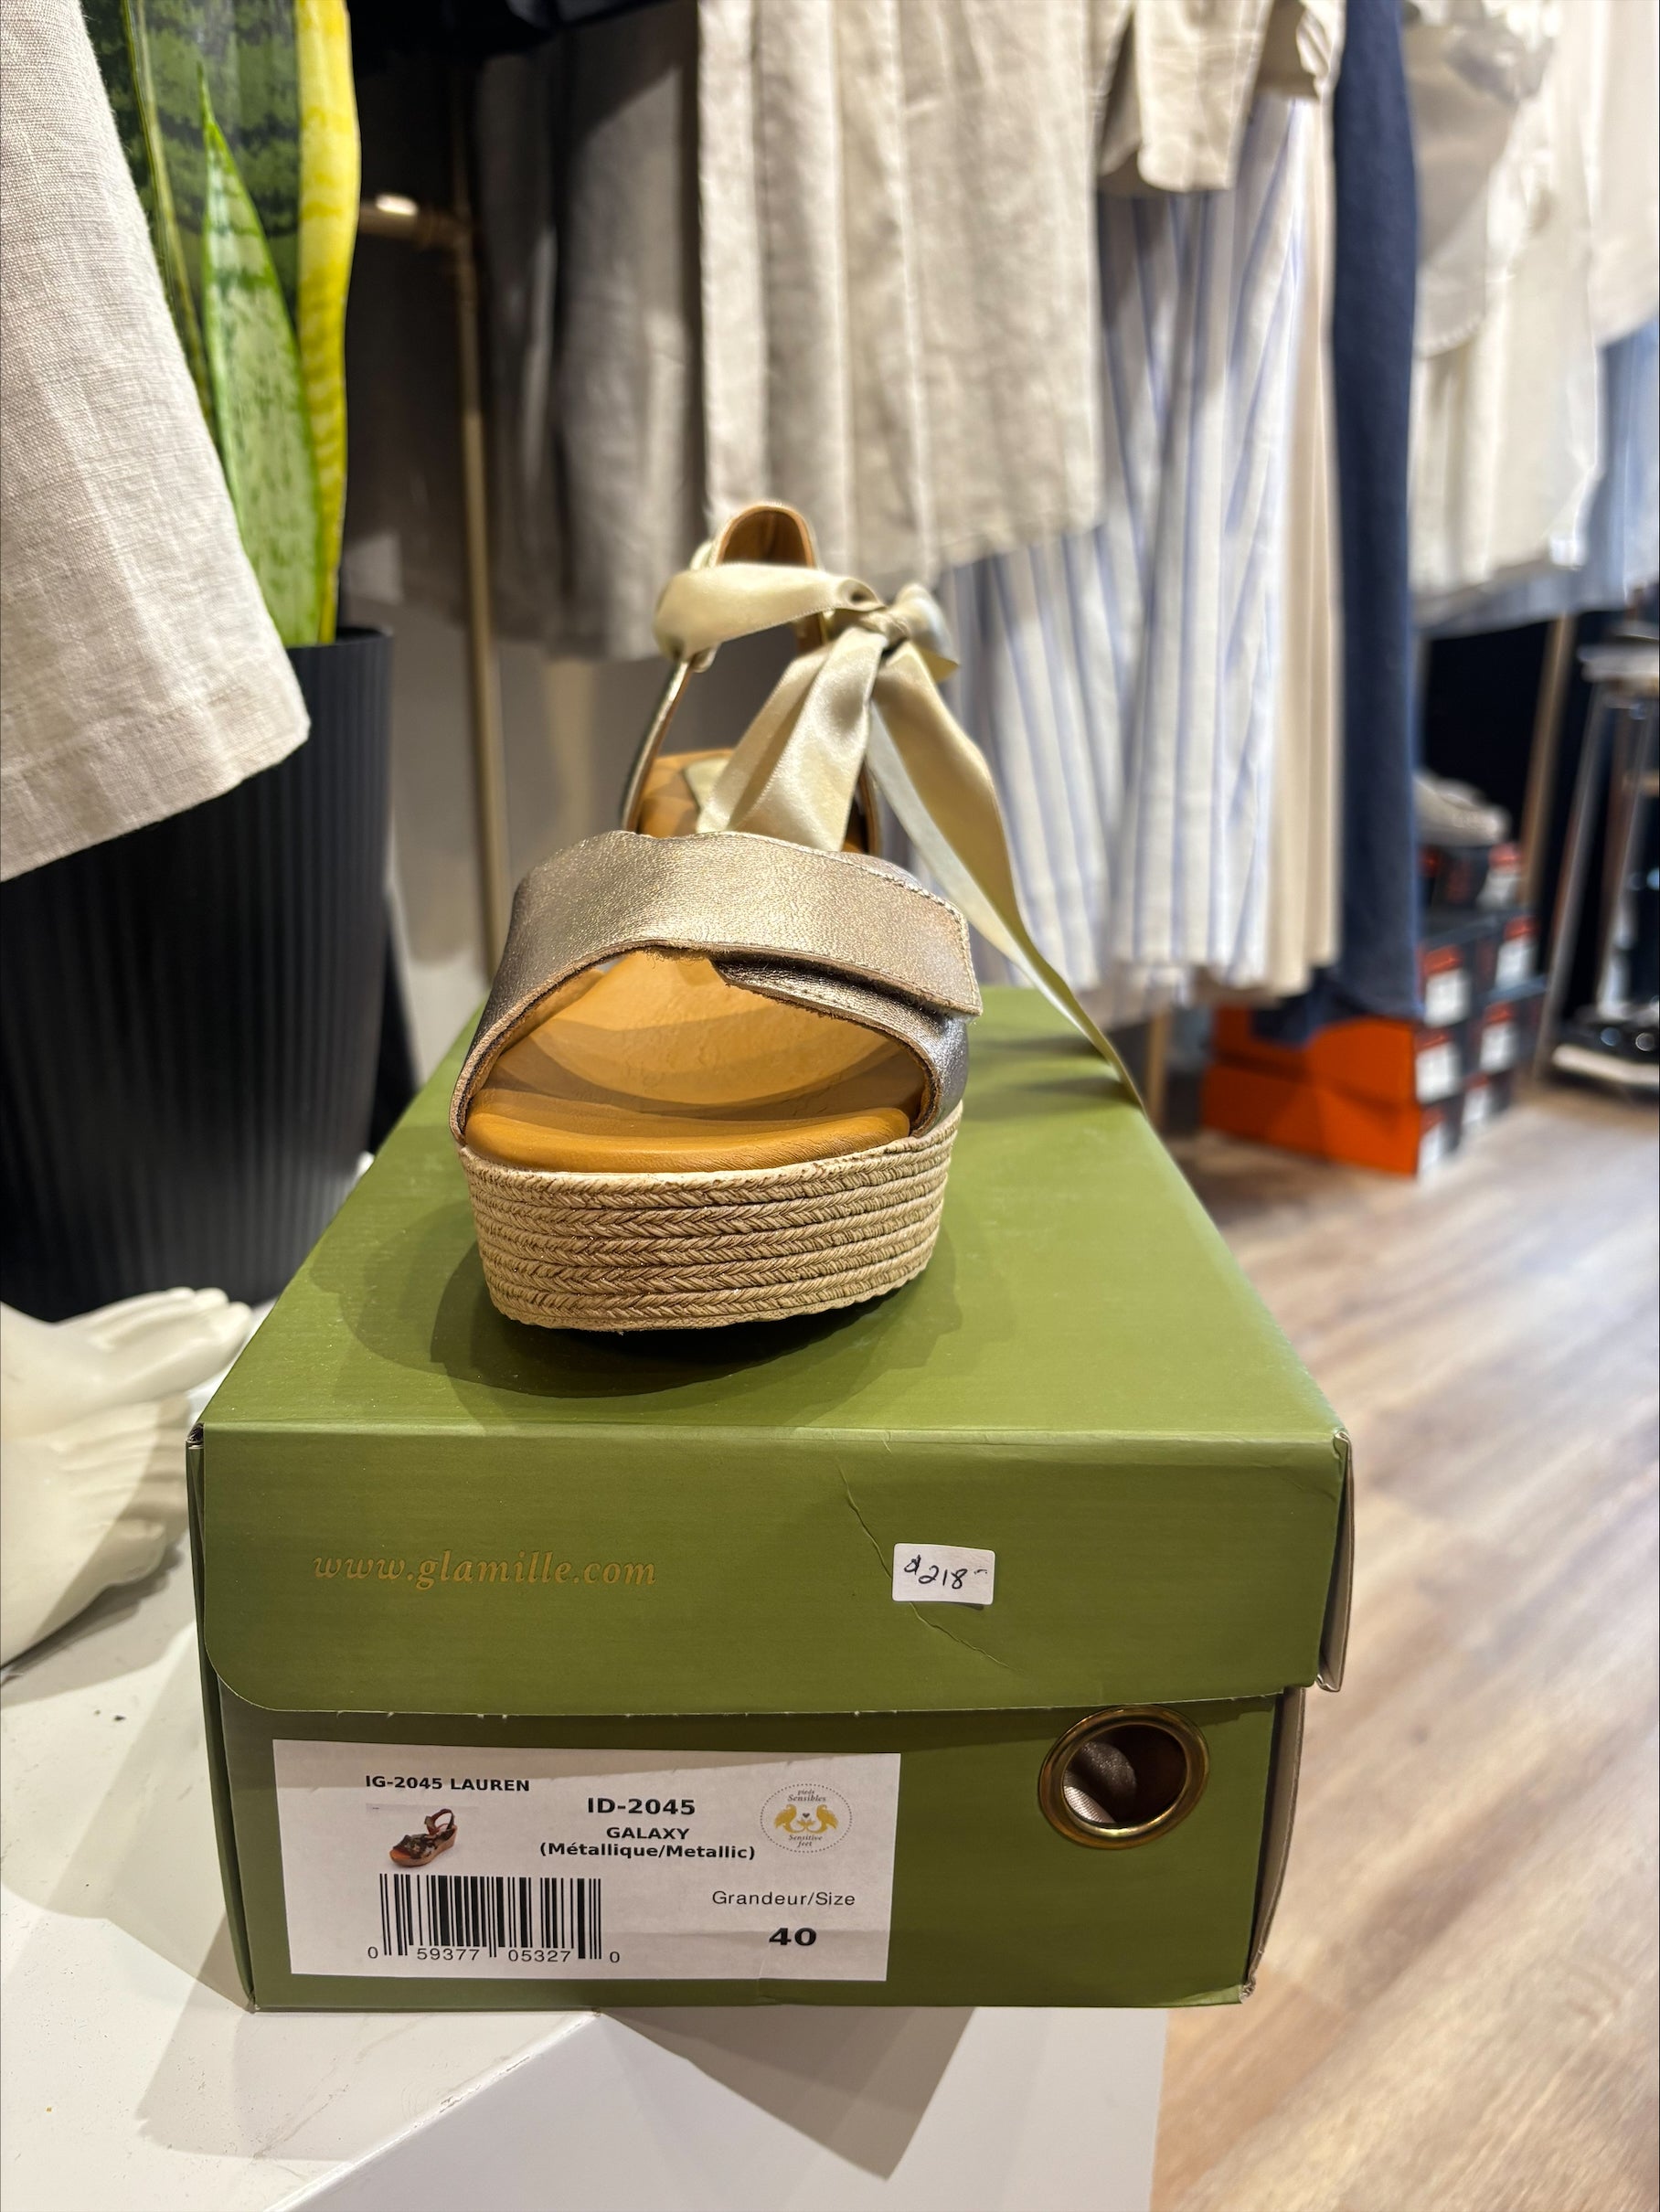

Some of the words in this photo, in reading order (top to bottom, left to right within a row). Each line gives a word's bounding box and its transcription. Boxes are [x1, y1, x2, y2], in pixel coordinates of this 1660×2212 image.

[313, 1549, 657, 1590] www.glamille.com
[366, 1775, 443, 1790] IG-2045
[450, 1778, 530, 1792] LAUREN
[587, 1797, 697, 1815] ID-2045
[787, 1793, 826, 1803] Sensibles
[606, 1826, 690, 1840] GALAXY
[539, 1842, 756, 1860] (Métallique/Metallic)
[712, 1890, 856, 1906] Grandeur/Size
[768, 1927, 817, 1946] 40
[367, 1946, 378, 1959] 0
[416, 1947, 481, 1962] 59377
[507, 1949, 572, 1962] 05327
[609, 1951, 621, 1963] 0
